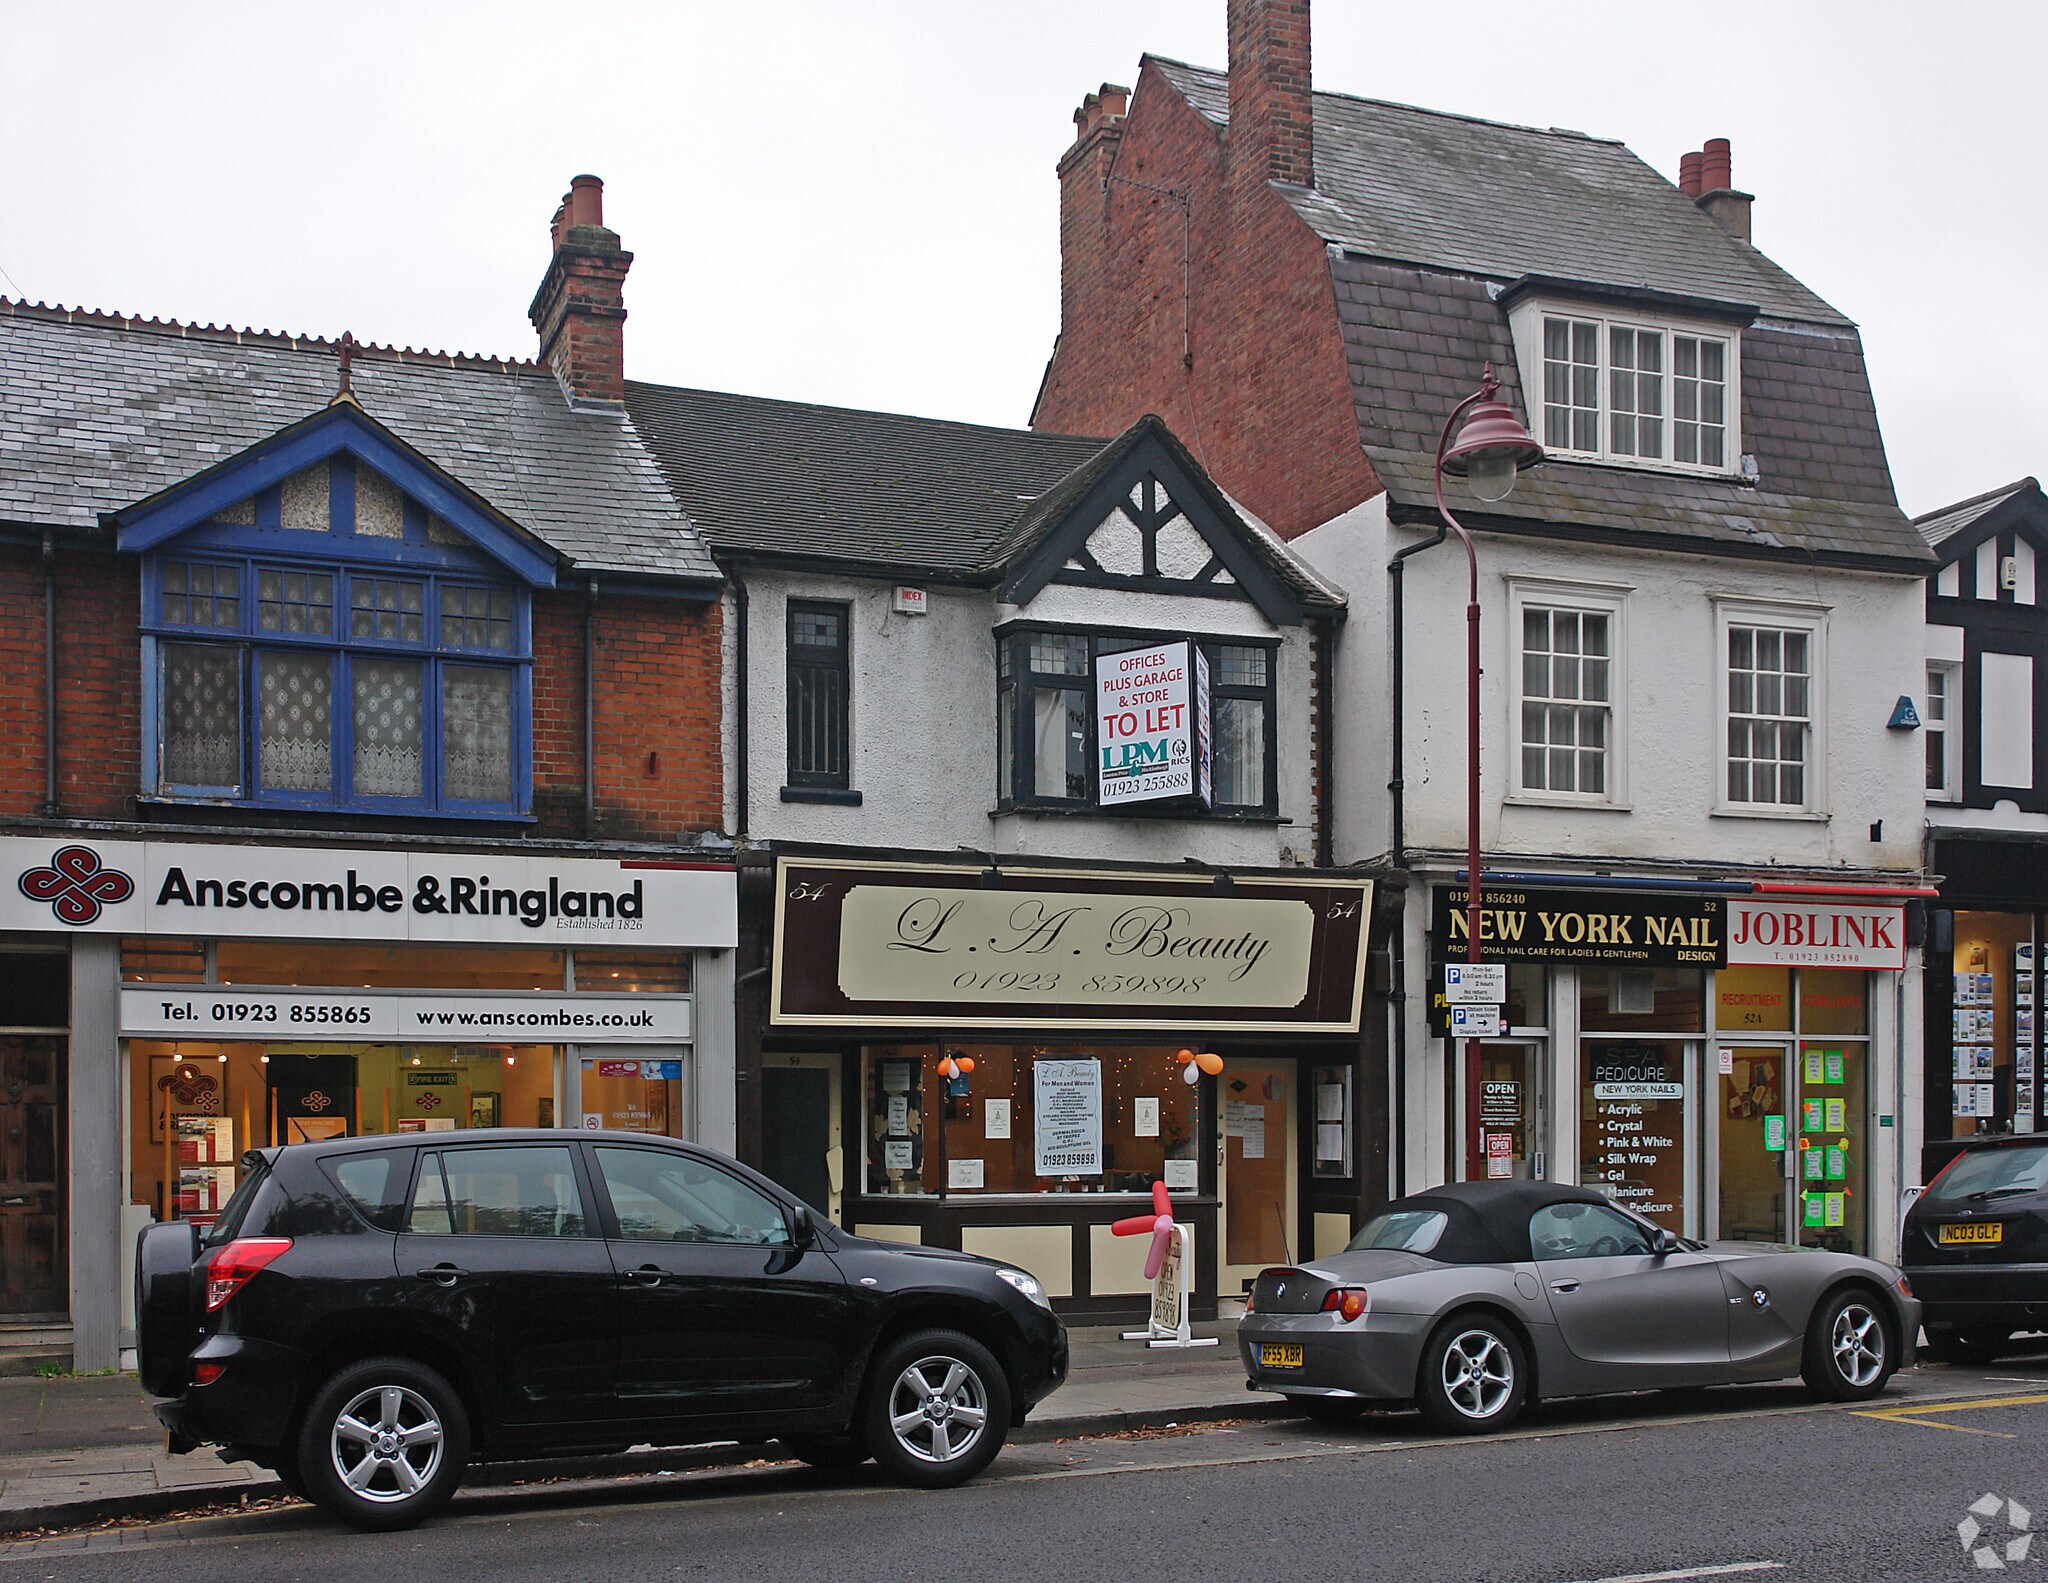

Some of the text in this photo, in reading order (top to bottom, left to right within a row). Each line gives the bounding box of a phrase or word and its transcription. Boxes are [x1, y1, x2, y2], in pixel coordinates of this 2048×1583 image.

[902, 590, 922, 601] INDEX
[1119, 653, 1166, 672] OFFICES
[1104, 668, 1183, 692] PLUS GARAGE
[1119, 688, 1169, 708] & STORE
[1103, 703, 1186, 739] TO LET
[1102, 738, 1170, 770] LPM
[1171, 756, 1190, 766] RICS
[1104, 772, 1188, 797] 01923 255888
[156, 866, 403, 912] Anscombe
[789, 882, 832, 901] 54
[1486, 893, 1525, 904] 856240
[1326, 900, 1362, 919] 54
[1704, 902, 1716, 912] 52
[556, 918, 643, 930] Established 1826
[1449, 908, 1718, 947] NEW YORK NAIL
[1734, 911, 1896, 948] JOBLINK
[1105, 906, 1272, 982] Beauty
[1507, 947, 1525, 955] NAIL
[1528, 948, 1548, 956] CARE
[1550, 948, 1566, 956] FOR
[1568, 949, 1594, 957] LADIES
[1596, 950, 1600, 958] &
[1602, 950, 1648, 958] GENTLEMEN
[1678, 951, 1716, 962] DESIGN
[1774, 952, 1860, 962] T. 01923 852890
[953, 971, 1207, 994] 01923 859898
[1722, 993, 1782, 1006] RECRUITMENT
[161, 1002, 372, 1024] Tel. 01923 855865
[416, 1009, 654, 1027] www.anscombes.co.uk
[1744, 1013, 1762, 1024] 52A
[1606, 1048, 1658, 1065] SPA
[1068, 1066, 1095, 1080] Beauty
[1596, 1066, 1665, 1081] PEDICURE
[1486, 1084, 1514, 1094] OPEN
[1602, 1085, 1675, 1093] NEW YORK NAILS
[1606, 1104, 1642, 1117] Acrylic
[1606, 1120, 1643, 1134] Crystal
[1056, 1141, 1082, 1149] SCULPTURE
[1492, 1141, 1509, 1150] OPEN
[1606, 1136, 1673, 1148] Pink & White
[1043, 1154, 1095, 1166] 01923 859898
[1607, 1153, 1656, 1166] Silk Wrap
[1607, 1170, 1625, 1180] Gel
[1607, 1186, 1654, 1197] Manicure
[1629, 1202, 1673, 1212] Pedicure
[1946, 1224, 2000, 1240] NC03 GLF
[1161, 1262, 1173, 1281] OPEN
[1262, 1345, 1301, 1363] RF55 XBR
